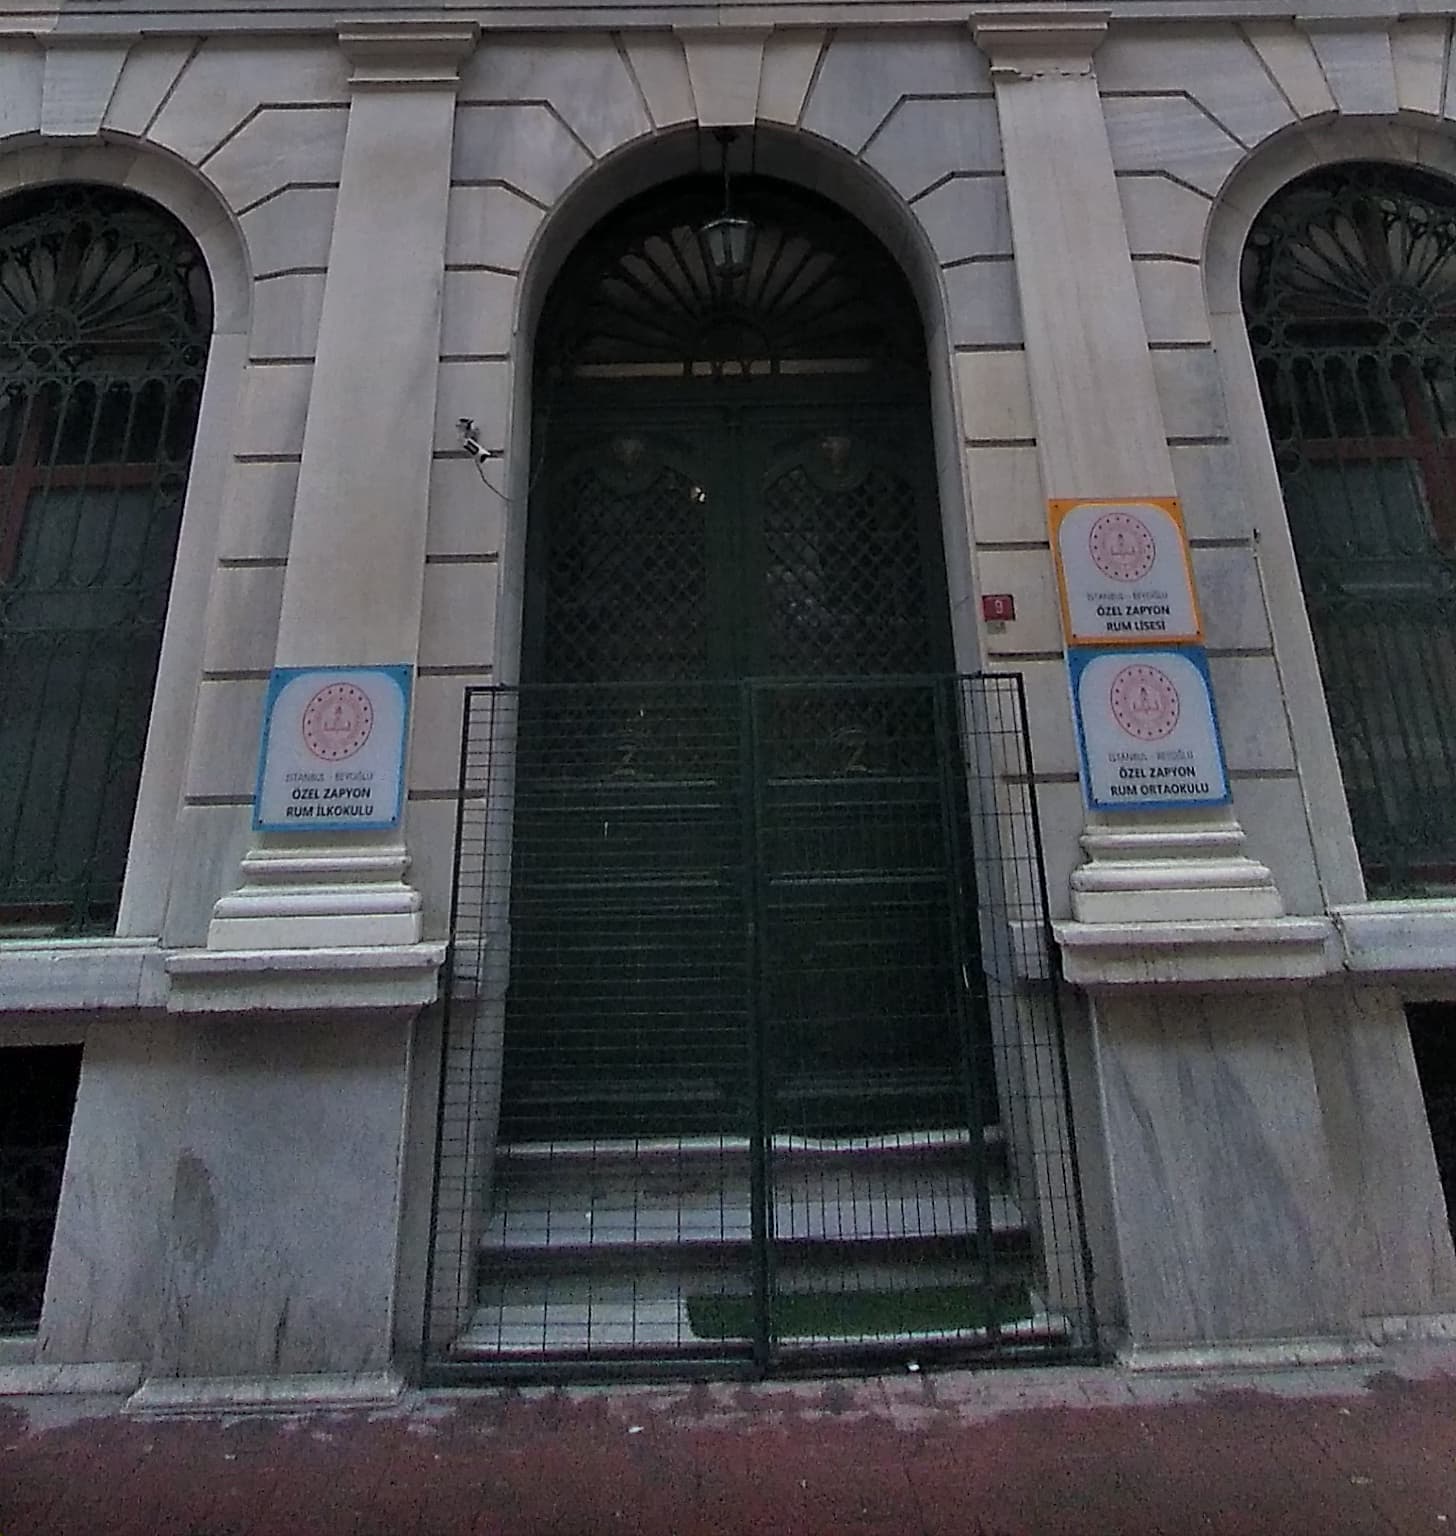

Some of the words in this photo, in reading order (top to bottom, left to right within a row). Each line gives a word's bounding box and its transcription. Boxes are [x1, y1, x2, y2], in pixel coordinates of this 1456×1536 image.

[995, 599, 1003, 614] 9
[1096, 604, 1123, 616] ÖZEL
[1125, 605, 1170, 616] ZAPYON
[1106, 621, 1132, 632] RUM
[1134, 618, 1166, 631] LİSESİ
[1119, 765, 1147, 779] ÖZEL
[1149, 765, 1196, 778] ZAPYON
[292, 786, 320, 800] ÖZEL
[322, 787, 371, 800] ZAPYON
[1110, 784, 1138, 796] RUM
[1140, 782, 1210, 795] ORTAOKULU
[286, 806, 314, 817] RUM
[316, 803, 374, 817] İLKOKULU
